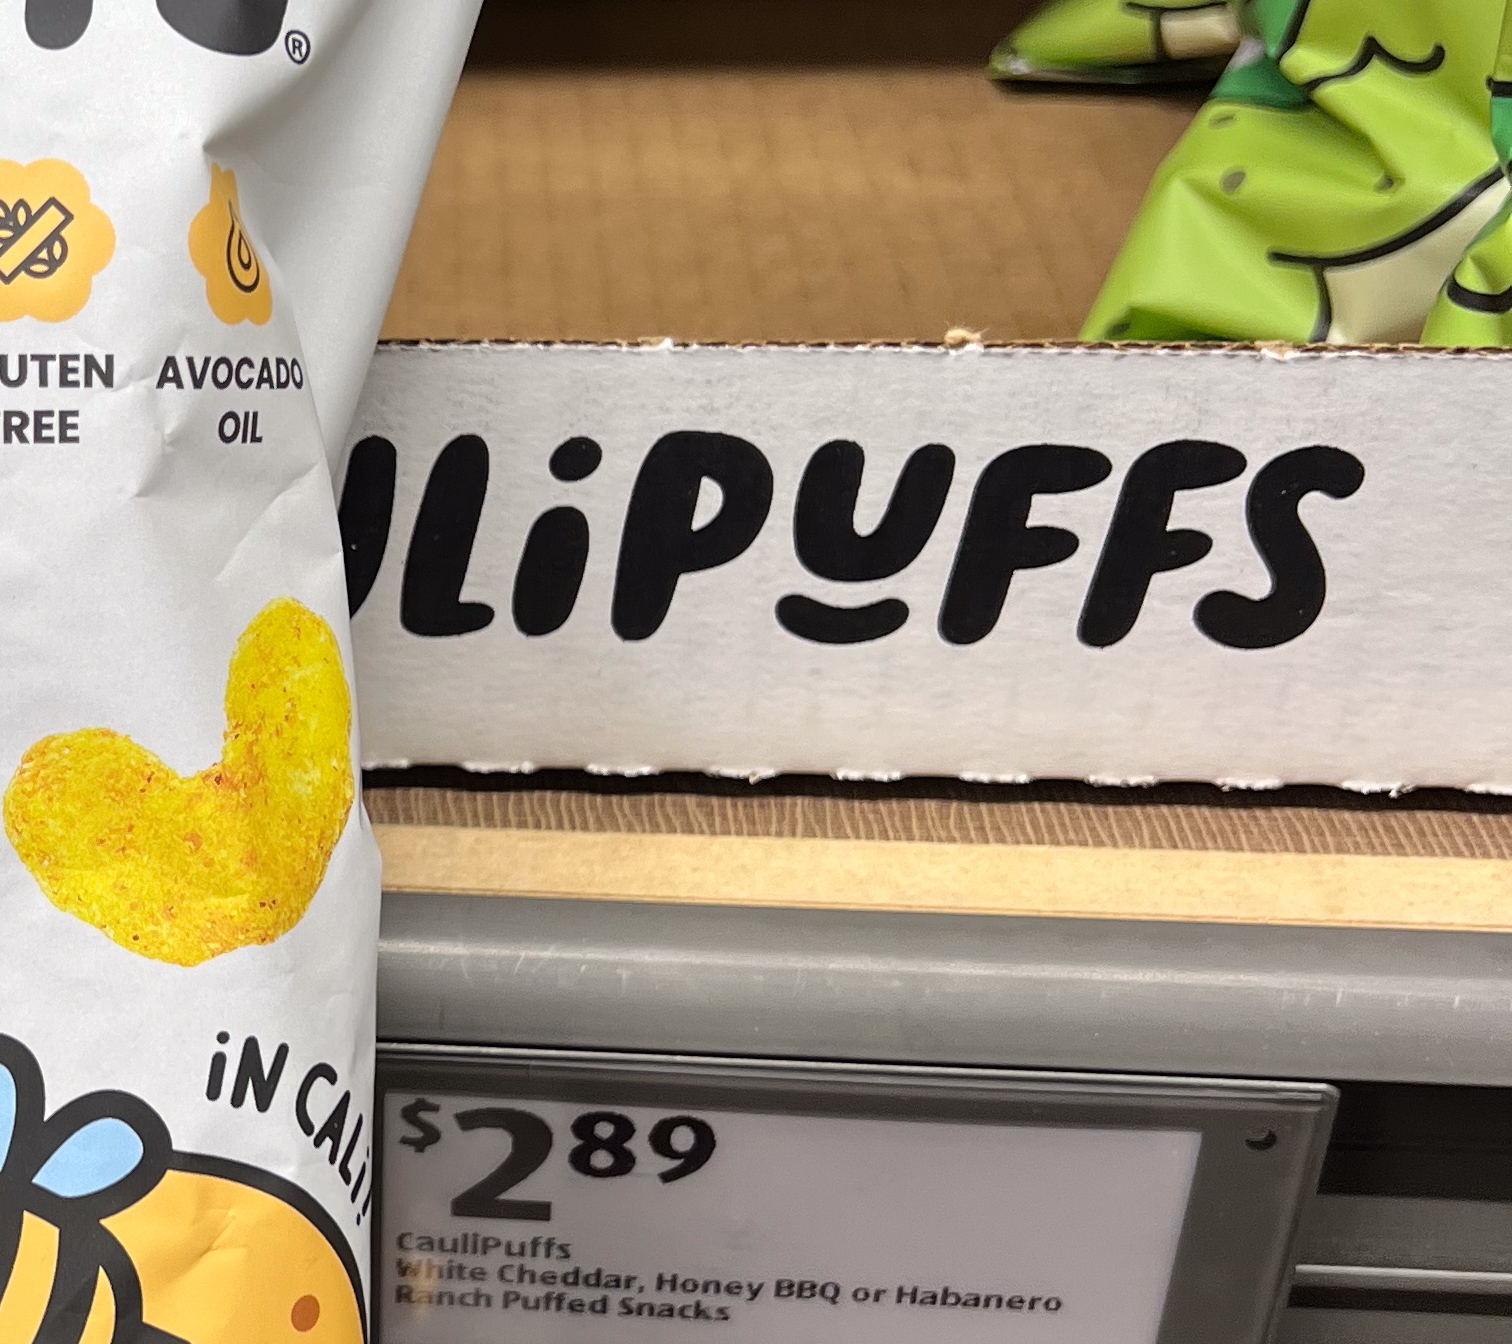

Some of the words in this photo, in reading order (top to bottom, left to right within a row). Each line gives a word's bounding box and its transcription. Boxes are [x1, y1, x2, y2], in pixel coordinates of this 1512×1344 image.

[156, 354, 304, 391] AVOCADO
[217, 409, 263, 445] OIL
[395, 1231, 573, 1259] CauliPuffs
[395, 1258, 488, 1282] White
[496, 1263, 646, 1294] Cheddar,
[654, 1272, 765, 1301] Honey
[774, 1278, 842, 1305] BBQ
[851, 1287, 887, 1303] or
[896, 1285, 1064, 1313] Habanero
[395, 1285, 492, 1308] Ranch
[501, 1290, 610, 1316] Puffed
[617, 1295, 732, 1322] Snacks
